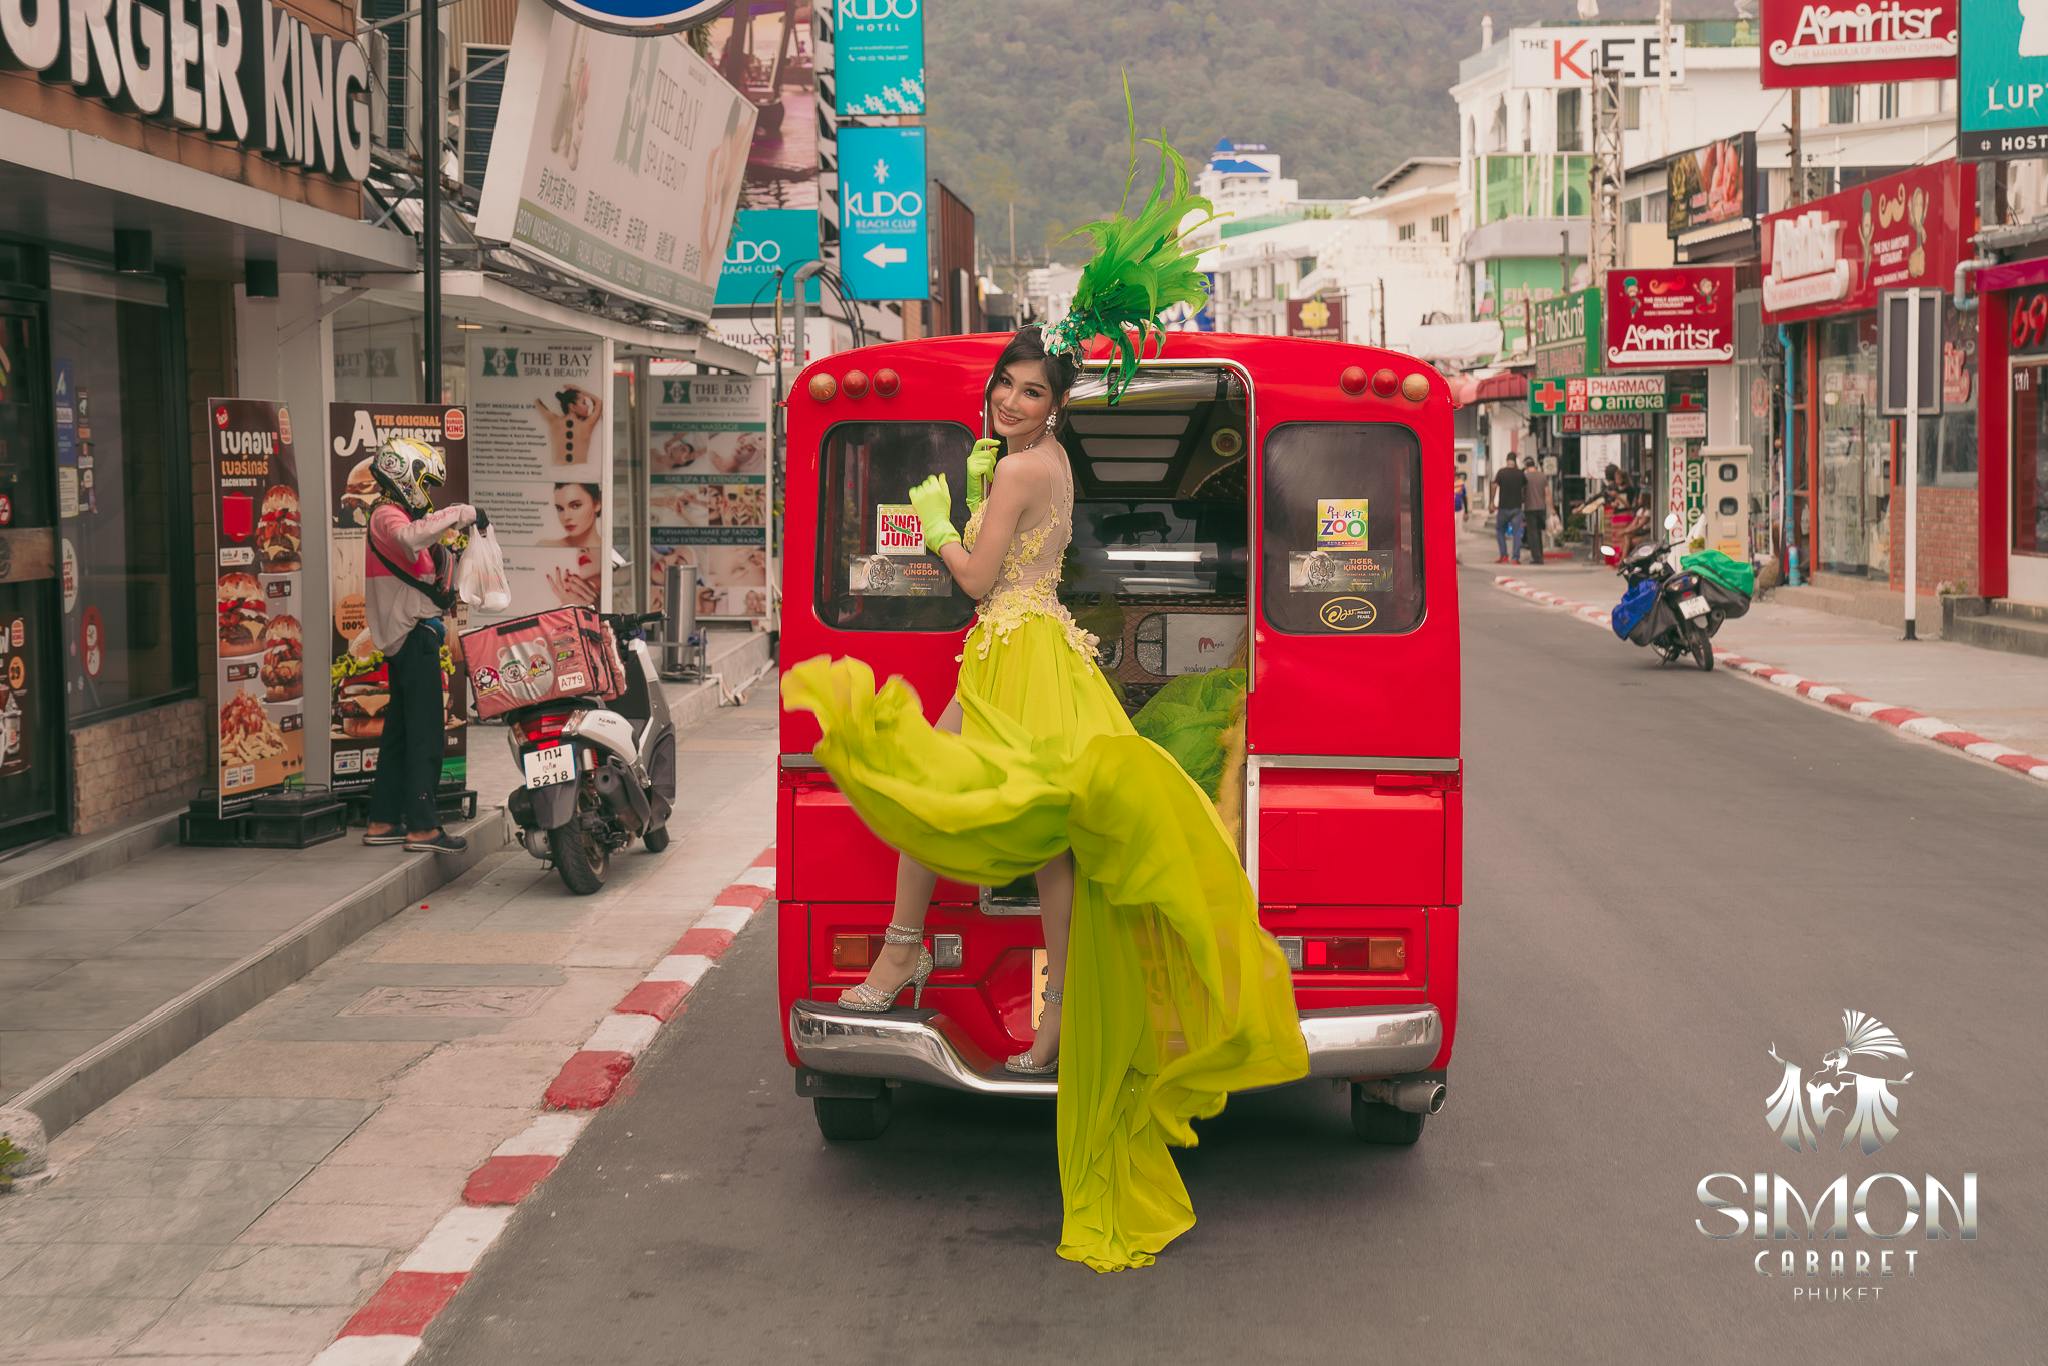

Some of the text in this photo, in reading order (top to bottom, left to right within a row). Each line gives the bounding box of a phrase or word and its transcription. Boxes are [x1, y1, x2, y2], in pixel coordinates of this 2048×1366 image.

[856, 24, 900, 32] HOTEL
[1792, 1, 1942, 46] Amritsr
[1520, 38, 1677, 80] THE KEE
[263, 6, 371, 182] KING
[844, 181, 923, 228] KUDO
[856, 219, 916, 228] BEACH CLUB
[721, 265, 752, 274] EACH
[1622, 323, 1720, 351] Amritsr
[520, 352, 592, 367] THE BAY
[525, 367, 590, 378] SPA & BEAUTY
[693, 383, 752, 395] THE BAY
[1591, 379, 1664, 394] PHARMACY
[1606, 395, 1663, 409] аптека
[374, 415, 441, 427] THE ORIGINAL
[1582, 413, 1641, 428] PHARMACY
[446, 425, 464, 433] KING
[1327, 505, 1363, 519] PHUKET
[1321, 519, 1366, 538] ZOO
[880, 532, 923, 547] JUMP
[342, 621, 365, 631] 100%
[532, 770, 569, 787] 5218
